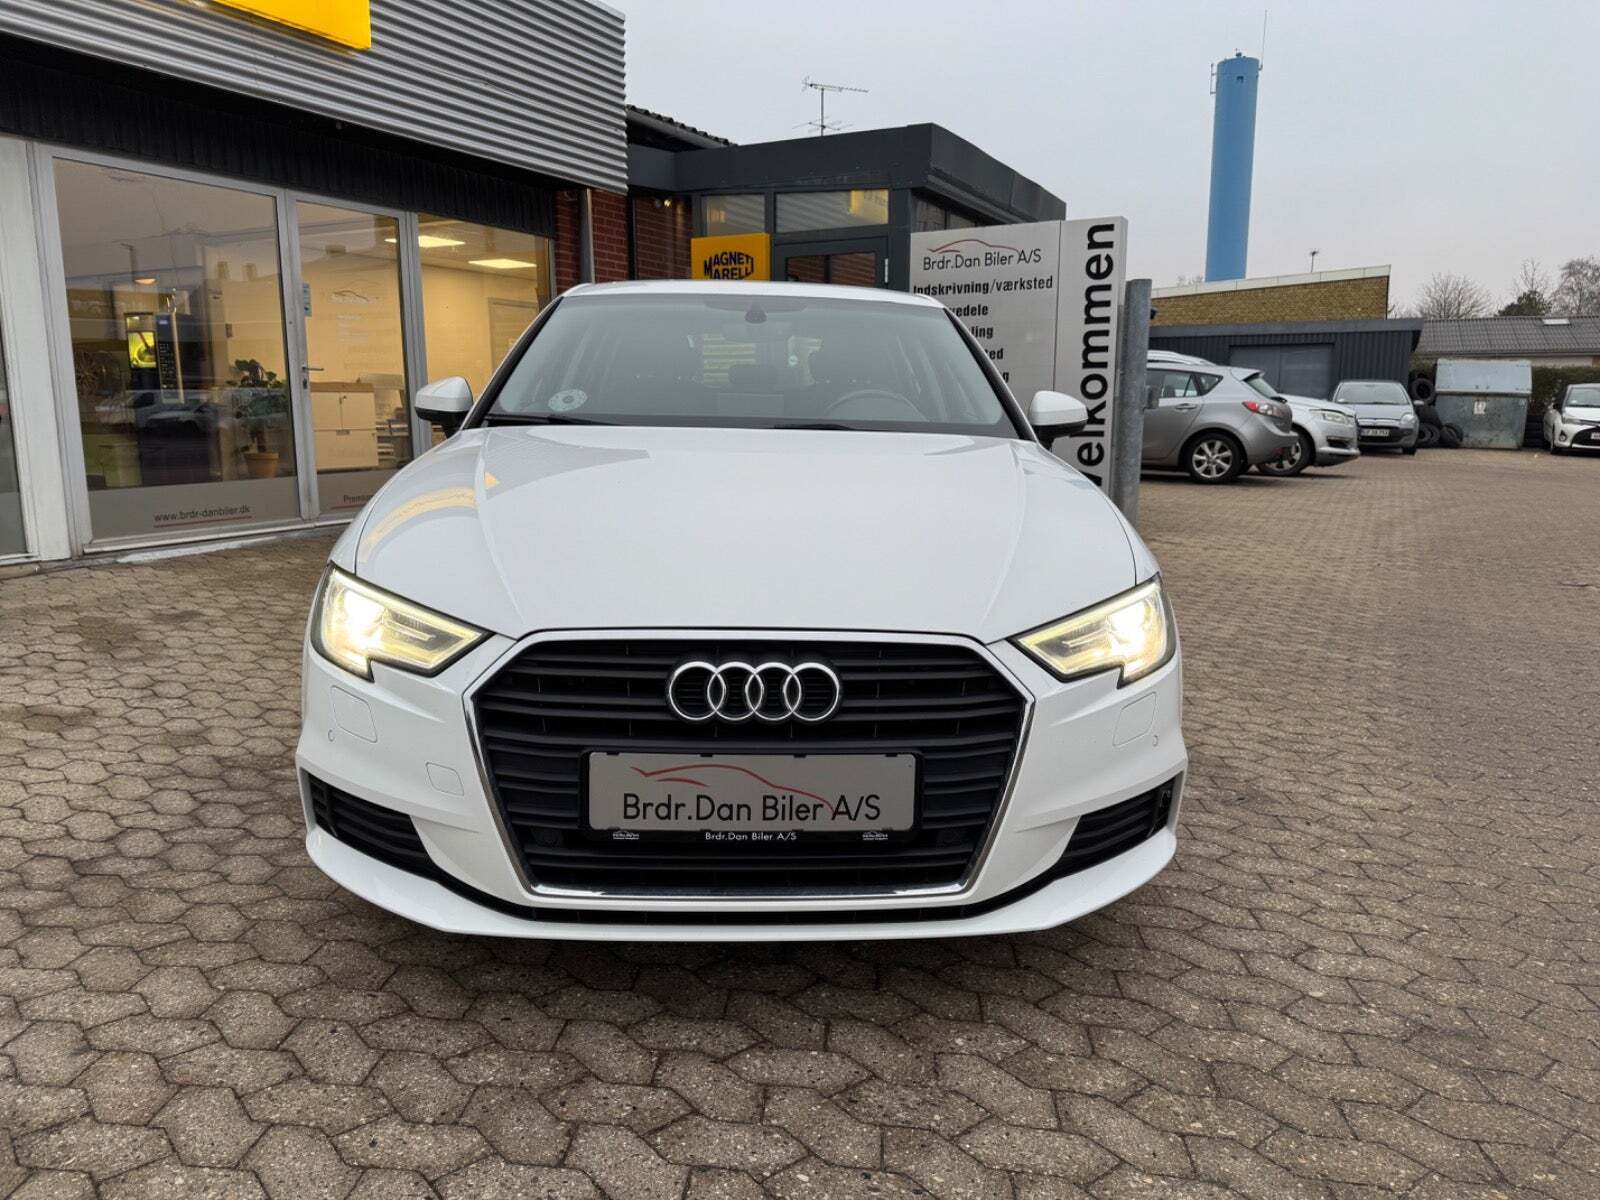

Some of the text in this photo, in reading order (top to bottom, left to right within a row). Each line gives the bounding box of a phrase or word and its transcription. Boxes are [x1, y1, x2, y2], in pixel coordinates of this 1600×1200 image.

[923, 248, 1042, 271] Brdr.Dan Biler A/S
[623, 793, 881, 822] Brdr.Dan Biler A/S
[705, 832, 797, 841] Brdr.Dan Biler A/S
